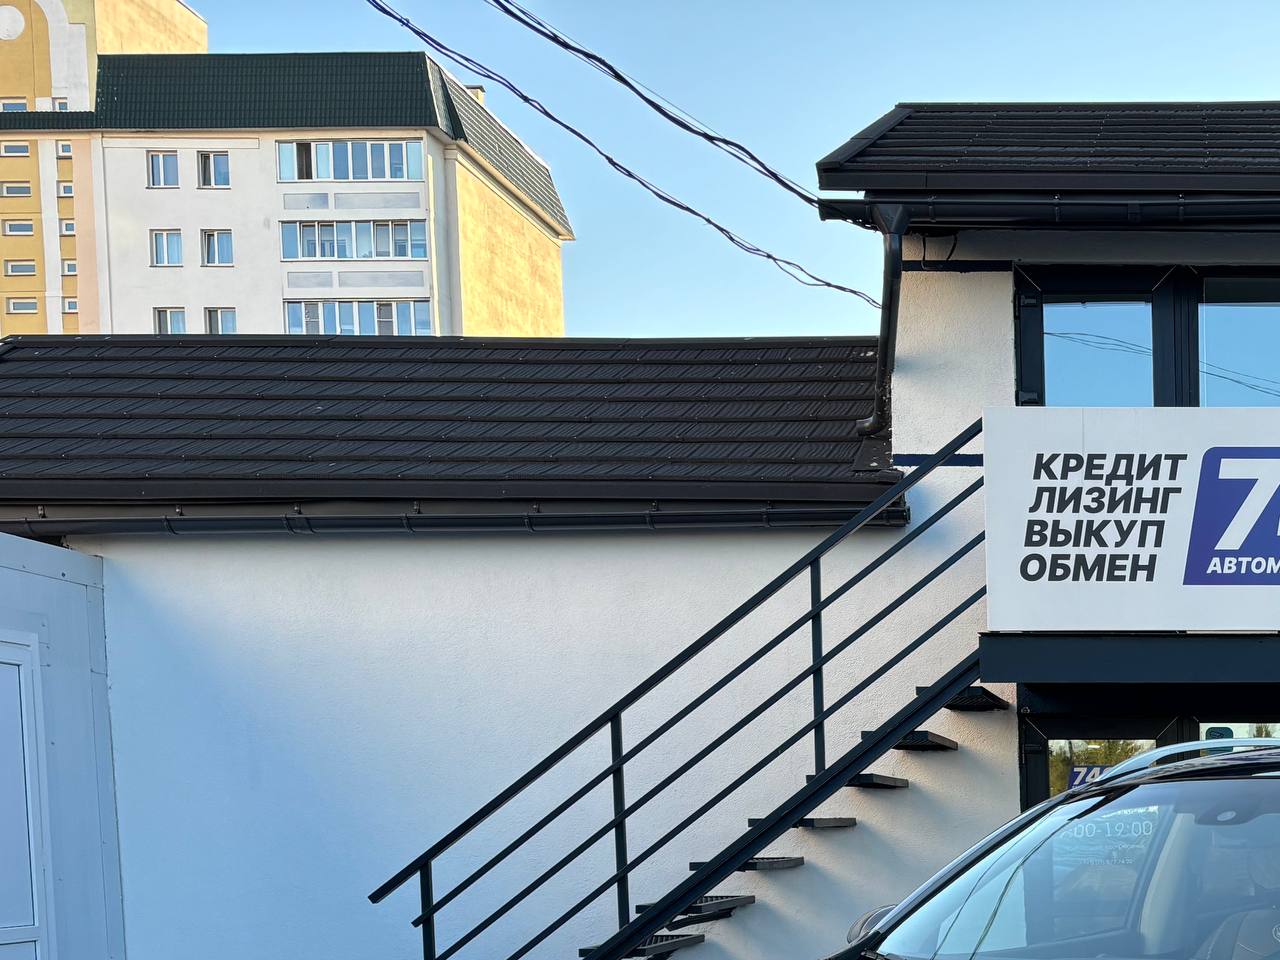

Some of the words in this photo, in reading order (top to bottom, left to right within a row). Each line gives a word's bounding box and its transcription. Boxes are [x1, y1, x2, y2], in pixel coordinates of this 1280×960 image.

[1032, 453, 1188, 487] КРЕДИТ
[1028, 486, 1183, 514] ЛИЗИНГ
[1023, 519, 1166, 548] ВЫКУП
[1019, 553, 1158, 582] ОБМЕН
